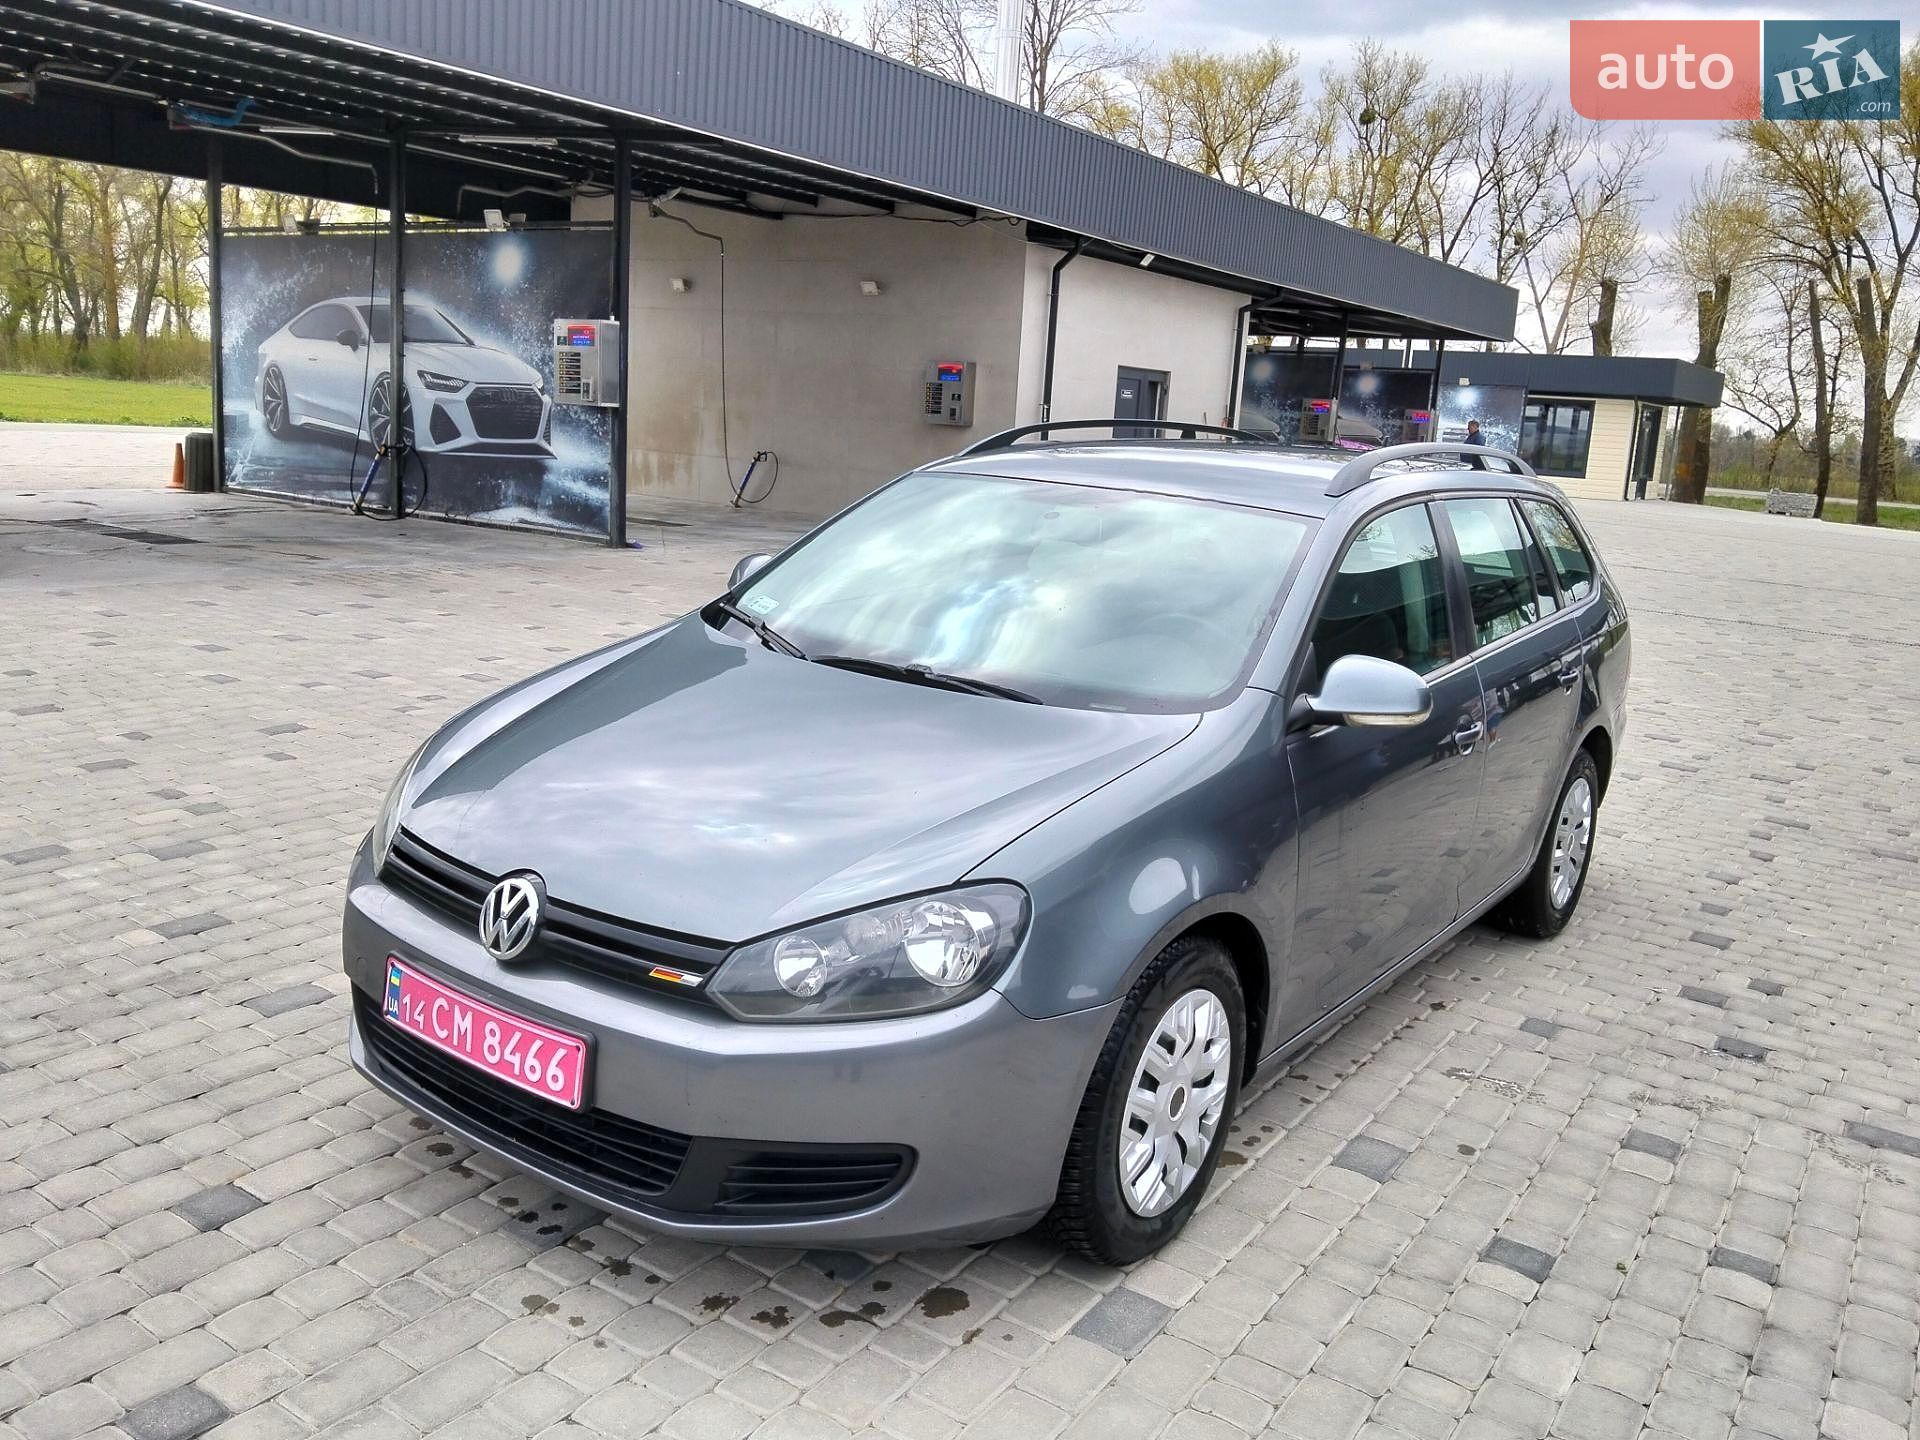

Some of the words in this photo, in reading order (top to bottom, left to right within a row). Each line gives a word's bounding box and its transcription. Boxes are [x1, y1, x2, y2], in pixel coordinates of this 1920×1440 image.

[388, 997, 399, 1015] UA
[402, 993, 425, 1030] 14
[483, 1022, 568, 1092] 8466
